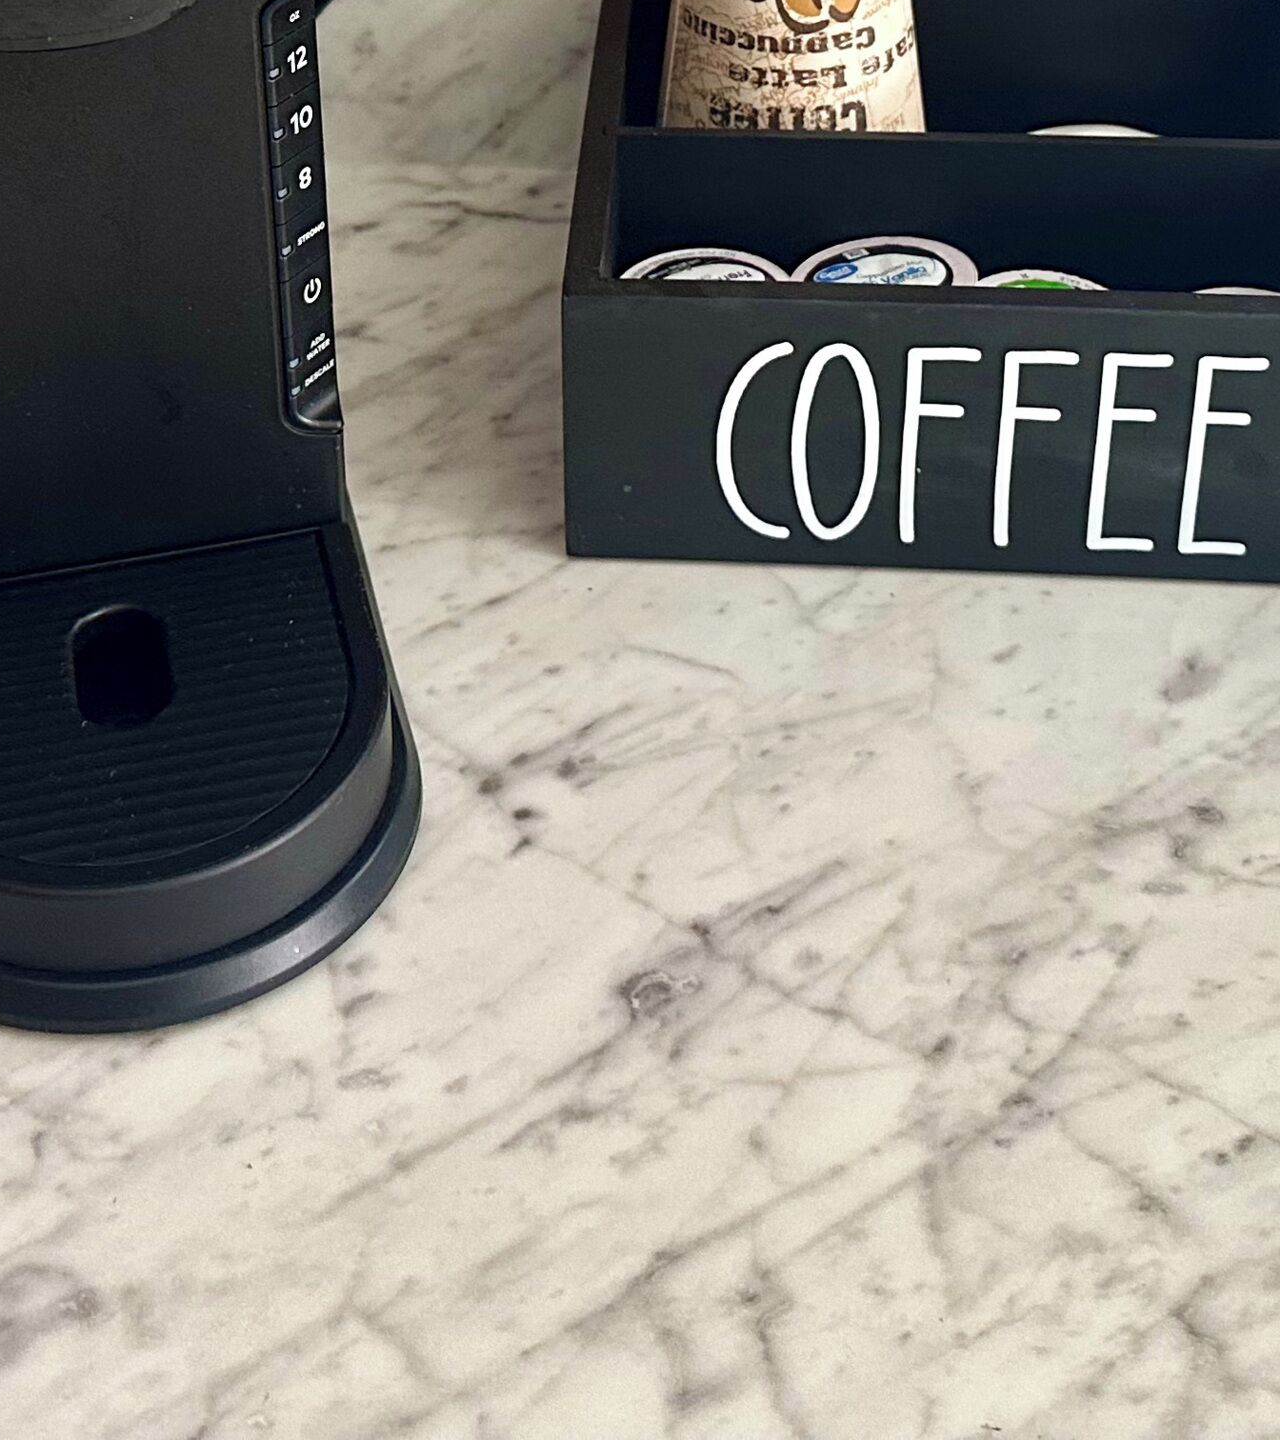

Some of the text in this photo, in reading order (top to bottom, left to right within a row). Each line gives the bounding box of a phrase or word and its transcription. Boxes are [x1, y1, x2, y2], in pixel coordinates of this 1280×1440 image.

[287, 45, 308, 74] 12
[729, 63, 848, 88] Latte
[290, 104, 313, 135] 10
[298, 166, 312, 189] 8
[297, 221, 326, 247] STRONG
[306, 338, 331, 361] WATER
[304, 358, 335, 387] DESCALE
[716, 340, 1270, 555] COFFEE
